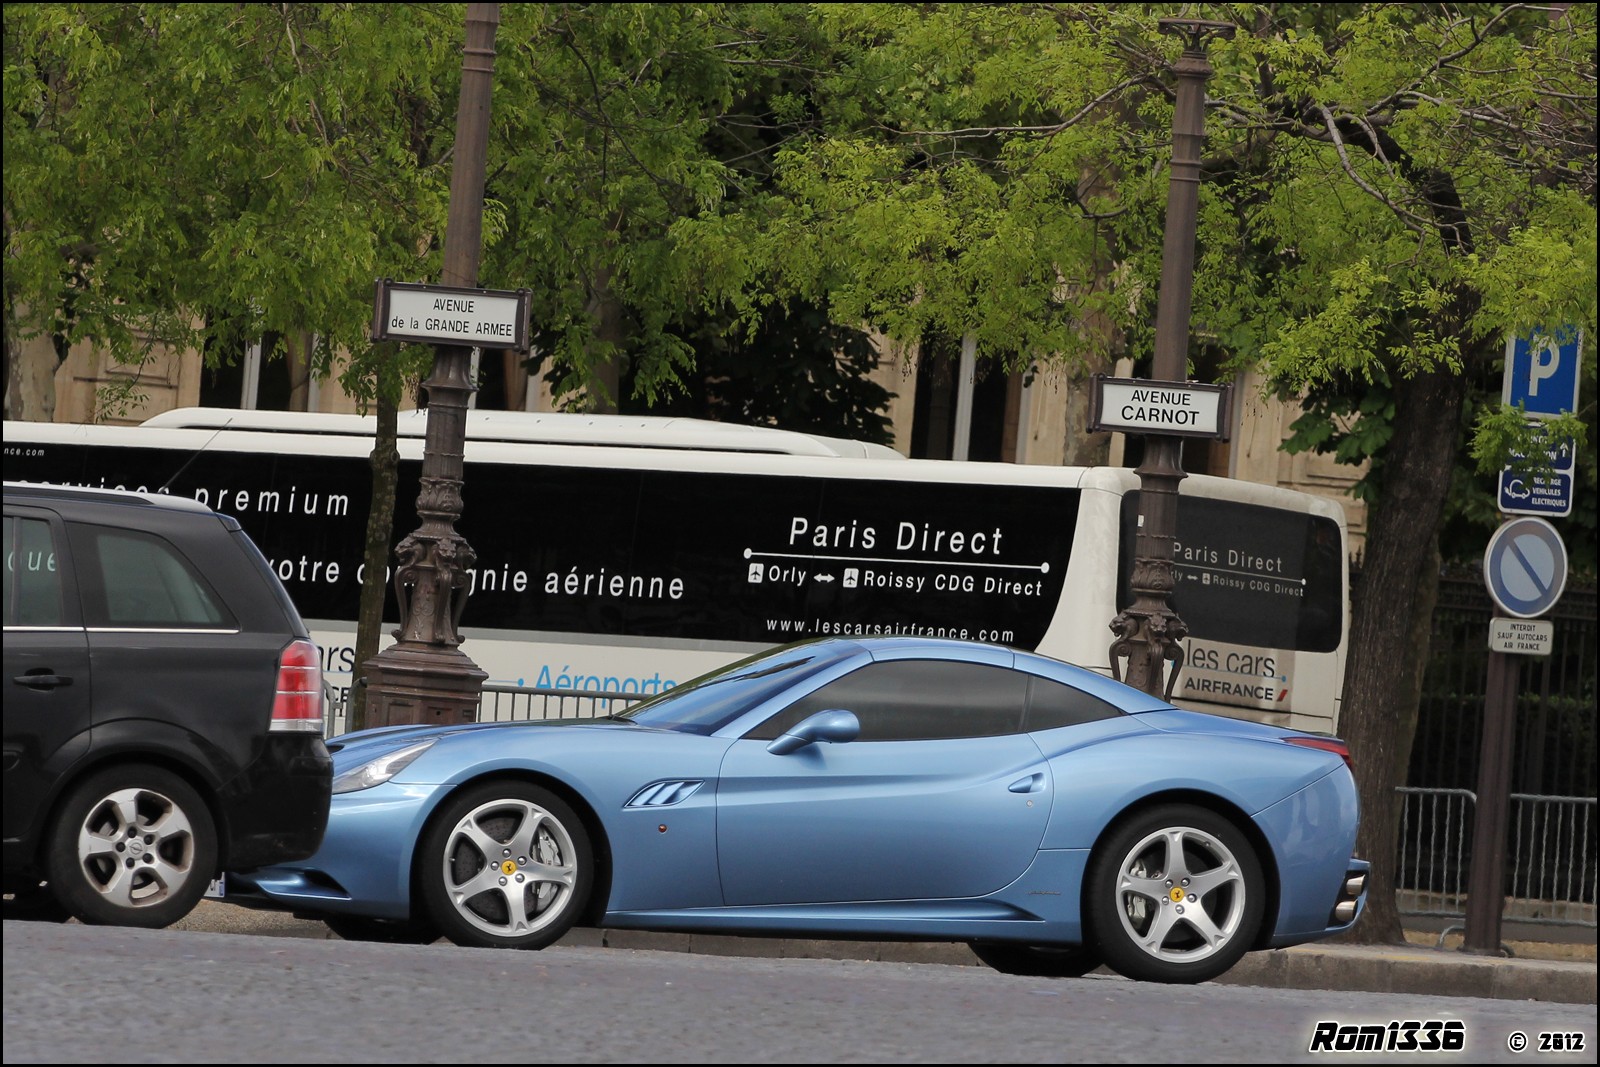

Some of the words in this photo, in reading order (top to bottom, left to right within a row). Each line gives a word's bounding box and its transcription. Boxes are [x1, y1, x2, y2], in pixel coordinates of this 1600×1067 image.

[433, 298, 475, 313] AVENUE
[391, 316, 405, 329] de
[410, 317, 419, 329] la
[425, 318, 470, 334] GRANDE
[475, 322, 513, 337] ARMEE
[1131, 389, 1192, 406] AVENUE
[1121, 405, 1200, 425] CARNOT
[194, 486, 349, 516] premium
[1531, 498, 1567, 508] ELECTRIQUES
[789, 517, 877, 549] Paris
[896, 521, 1003, 555] Direct
[1173, 541, 1218, 564] Paris
[1228, 549, 1282, 573] Direct
[544, 566, 684, 600] aérienne
[769, 565, 806, 587] Orly
[863, 570, 926, 593] Roissy
[934, 574, 975, 592] CDG
[984, 577, 1042, 596] Direct
[1212, 575, 1246, 590] Roissy
[1249, 580, 1271, 592] CDG
[1274, 583, 1304, 597] Direct
[766, 618, 1015, 642] www.lescarsairfrance.com
[1497, 631, 1513, 640] SAUF
[1516, 632, 1548, 642] AUTOCARS
[1509, 623, 1536, 632] INTERDIT
[1503, 641, 1514, 649] AIR
[1517, 642, 1540, 651] FRANCE
[1186, 639, 1219, 671] les
[1225, 652, 1276, 678] cars
[1184, 677, 1274, 701] AIRFRANCE
